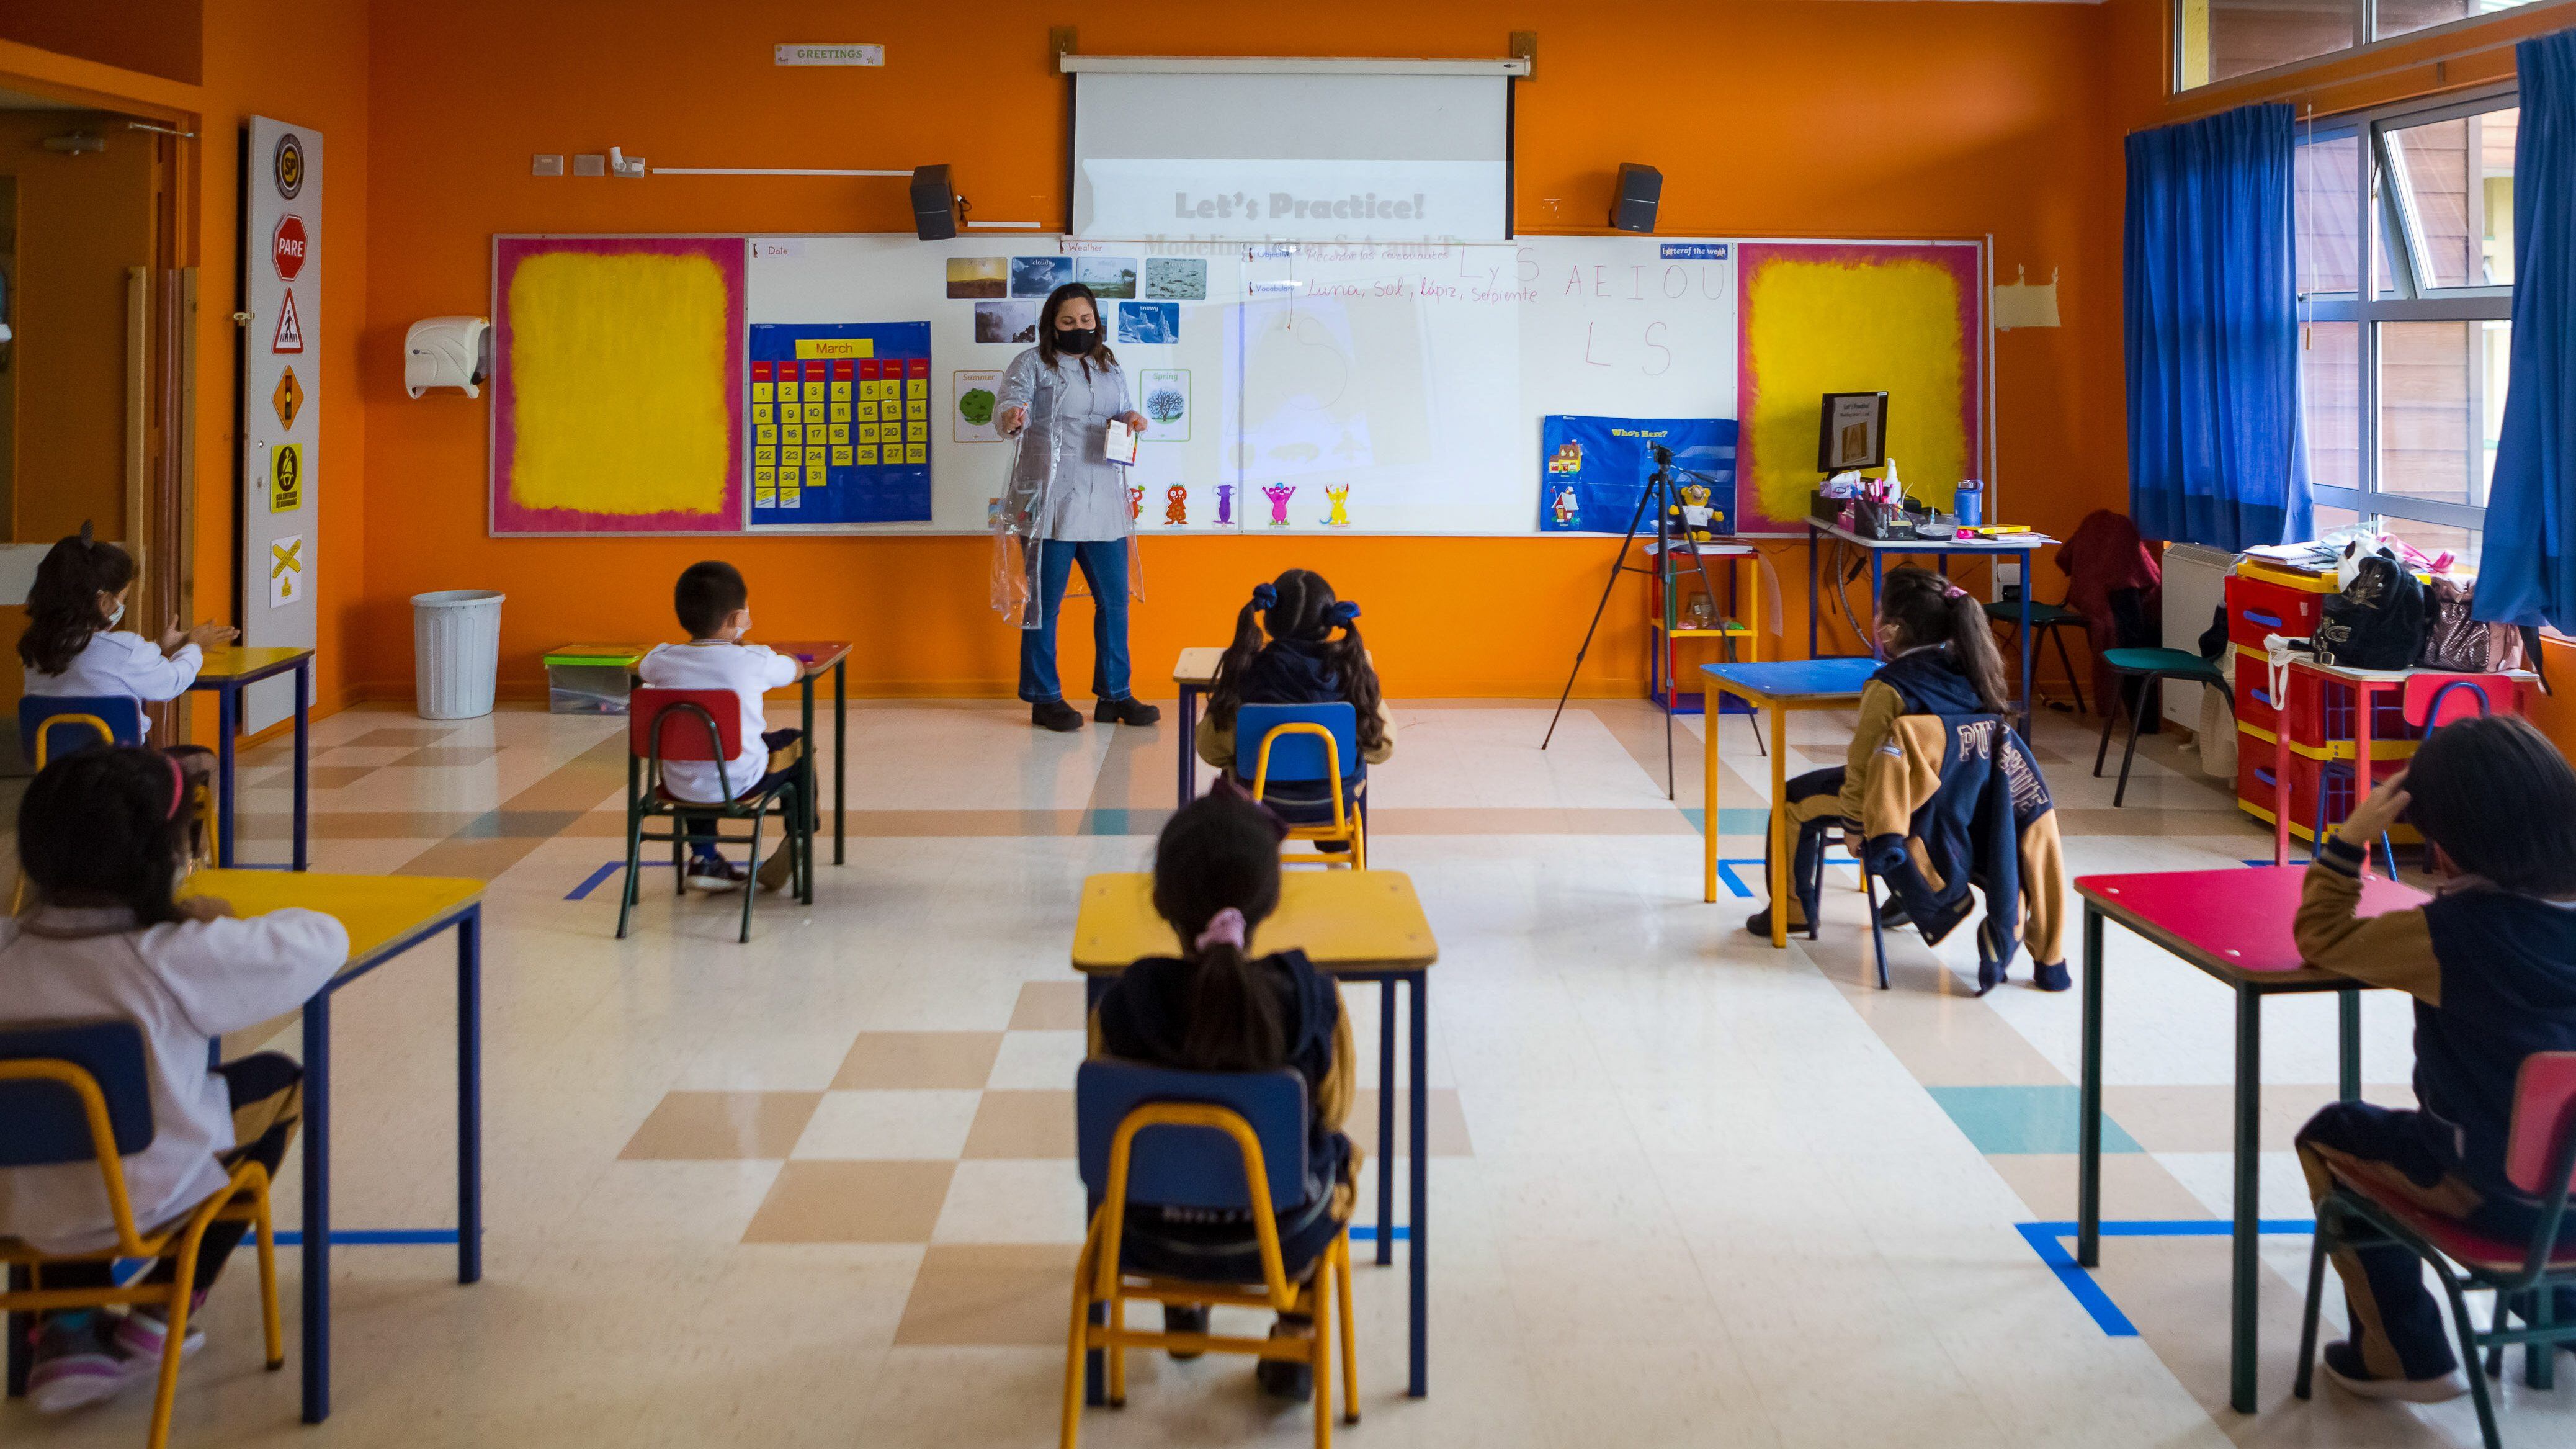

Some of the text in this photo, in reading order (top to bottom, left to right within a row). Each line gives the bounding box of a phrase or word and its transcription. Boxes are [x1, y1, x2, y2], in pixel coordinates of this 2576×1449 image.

[797, 49, 862, 59] GREETINGS
[1176, 191, 1424, 220] Let's Practice!
[279, 238, 304, 258] PARE
[769, 246, 788, 255] Date
[1068, 243, 1102, 251] Weather
[1460, 244, 1483, 279] L
[1514, 247, 1540, 282] S
[1256, 284, 1295, 293] Vocabulary
[815, 343, 853, 354] March
[1586, 321, 1671, 375] L S
[1153, 372, 1178, 382] Spring
[761, 384, 921, 396] 1 2 3 4 5 6 7
[759, 405, 922, 419] 8 9 10 11 12 13 14
[761, 426, 923, 439] 15 16 17 18 19 20 21
[1611, 429, 1640, 437] Who's
[759, 448, 923, 460] 22 23 24 25 26 27 28
[758, 470, 822, 481] 29 30 31
